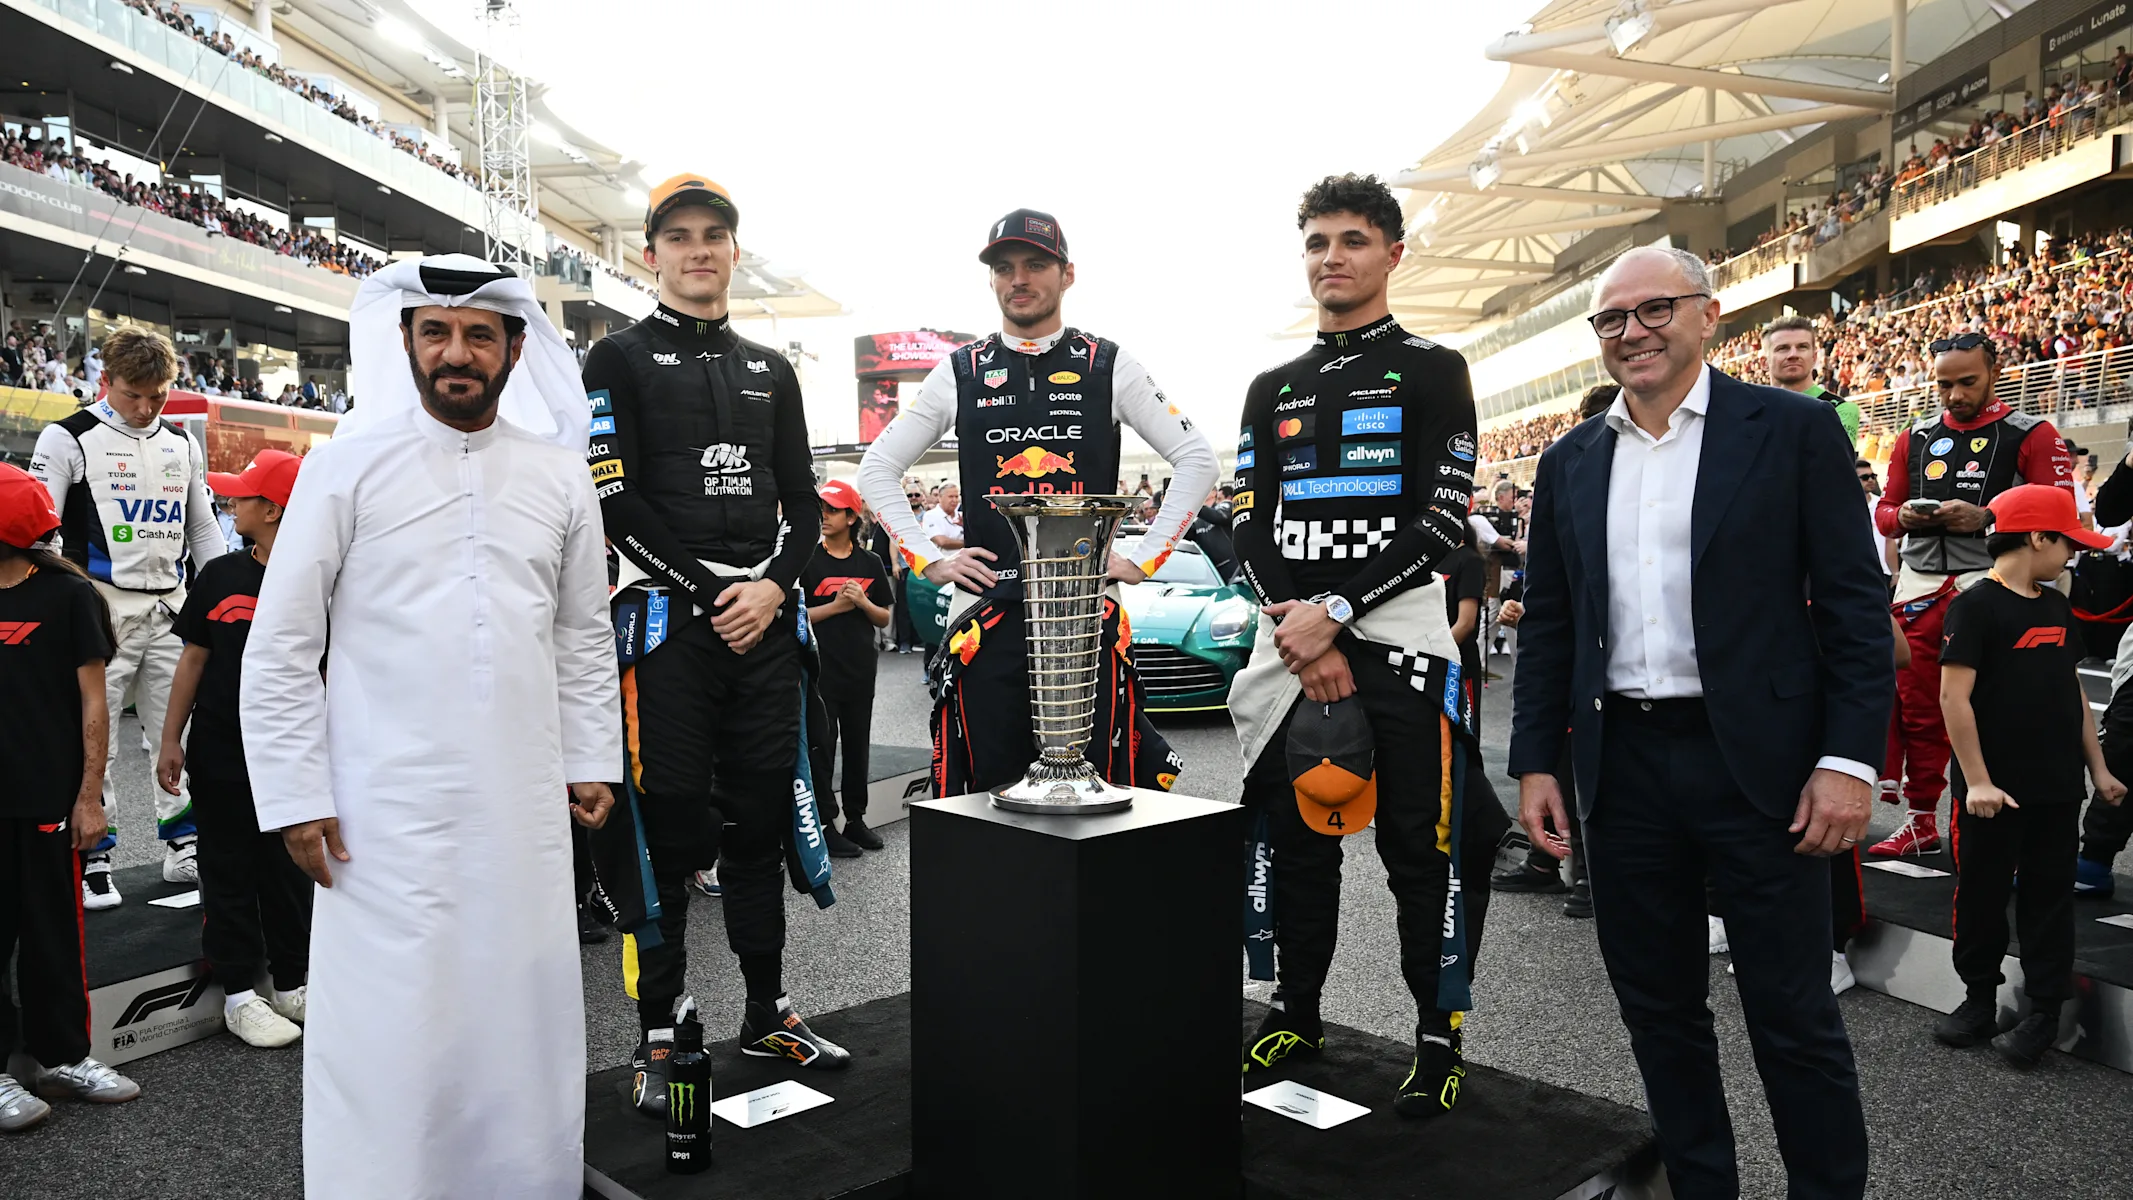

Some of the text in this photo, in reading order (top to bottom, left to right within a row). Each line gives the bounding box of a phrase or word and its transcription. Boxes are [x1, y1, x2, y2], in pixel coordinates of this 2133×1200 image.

[2091, 3, 2126, 30] Lunate
[2057, 24, 2084, 46] BRIDGE
[48, 197, 83, 214] CLUB
[889, 343, 906, 351] THE
[986, 370, 1006, 379] TAG
[977, 396, 1004, 408] Mobil
[1348, 389, 1392, 397] McLaren
[1275, 395, 1316, 412] Android
[985, 425, 1083, 444] ORACLE
[1347, 446, 1395, 463] allwyn
[111, 483, 136, 491] Mobil
[1306, 479, 1397, 495] Technologies
[112, 498, 182, 523] VISA
[166, 530, 182, 541] App
[886, 525, 899, 540] Bull
[1172, 511, 1194, 542] Red Bull
[625, 535, 698, 592] RICHARD MILLE
[1243, 560, 1266, 598] RICHARD
[1361, 553, 1430, 605] RICHARD MILLE
[626, 612, 636, 656] DP WORLD
[647, 618, 663, 655] ELL
[793, 778, 820, 849] allwyn
[1327, 811, 1345, 830] 4
[1247, 841, 1271, 913] allwyn
[140, 1027, 152, 1036] FIA
[153, 1019, 184, 1033] Formula
[140, 1016, 216, 1043] World Championship
[667, 1131, 697, 1140] MONSTER
[672, 1151, 690, 1160] OP81
